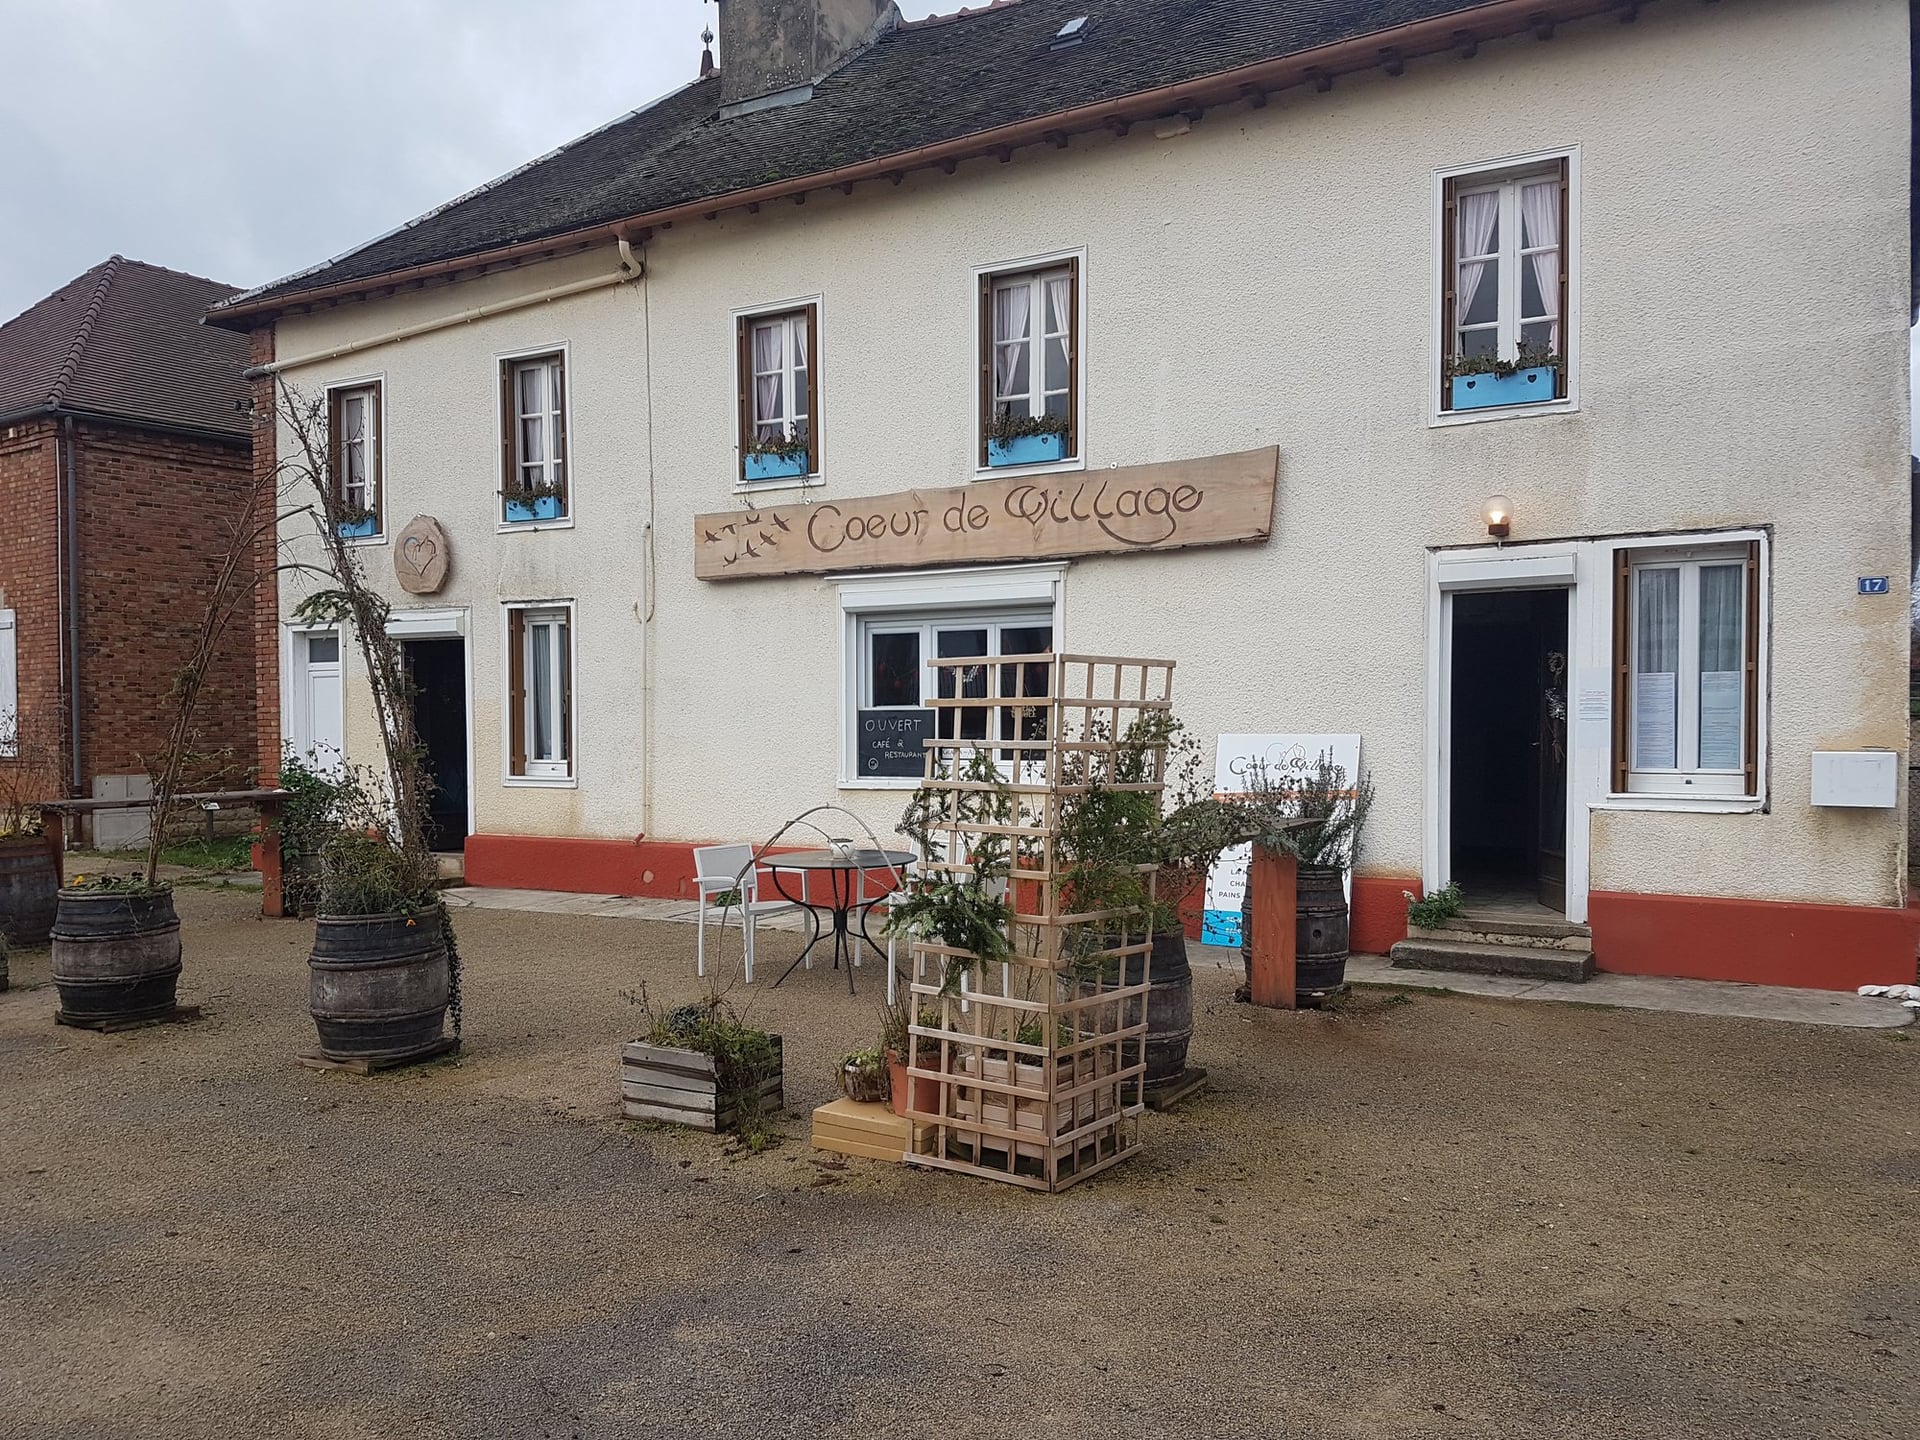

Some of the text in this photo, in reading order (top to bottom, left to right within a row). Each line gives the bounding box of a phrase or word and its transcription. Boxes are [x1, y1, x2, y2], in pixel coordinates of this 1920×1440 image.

[807, 480, 1204, 553] Coeur de Village
[1863, 579, 1883, 592] 17
[865, 719, 922, 732] OUVERT
[872, 737, 891, 749] CAFÉ
[884, 750, 927, 760] RESTAURANT
[1274, 759, 1290, 772] de
[1218, 891, 1241, 899] PAINS
